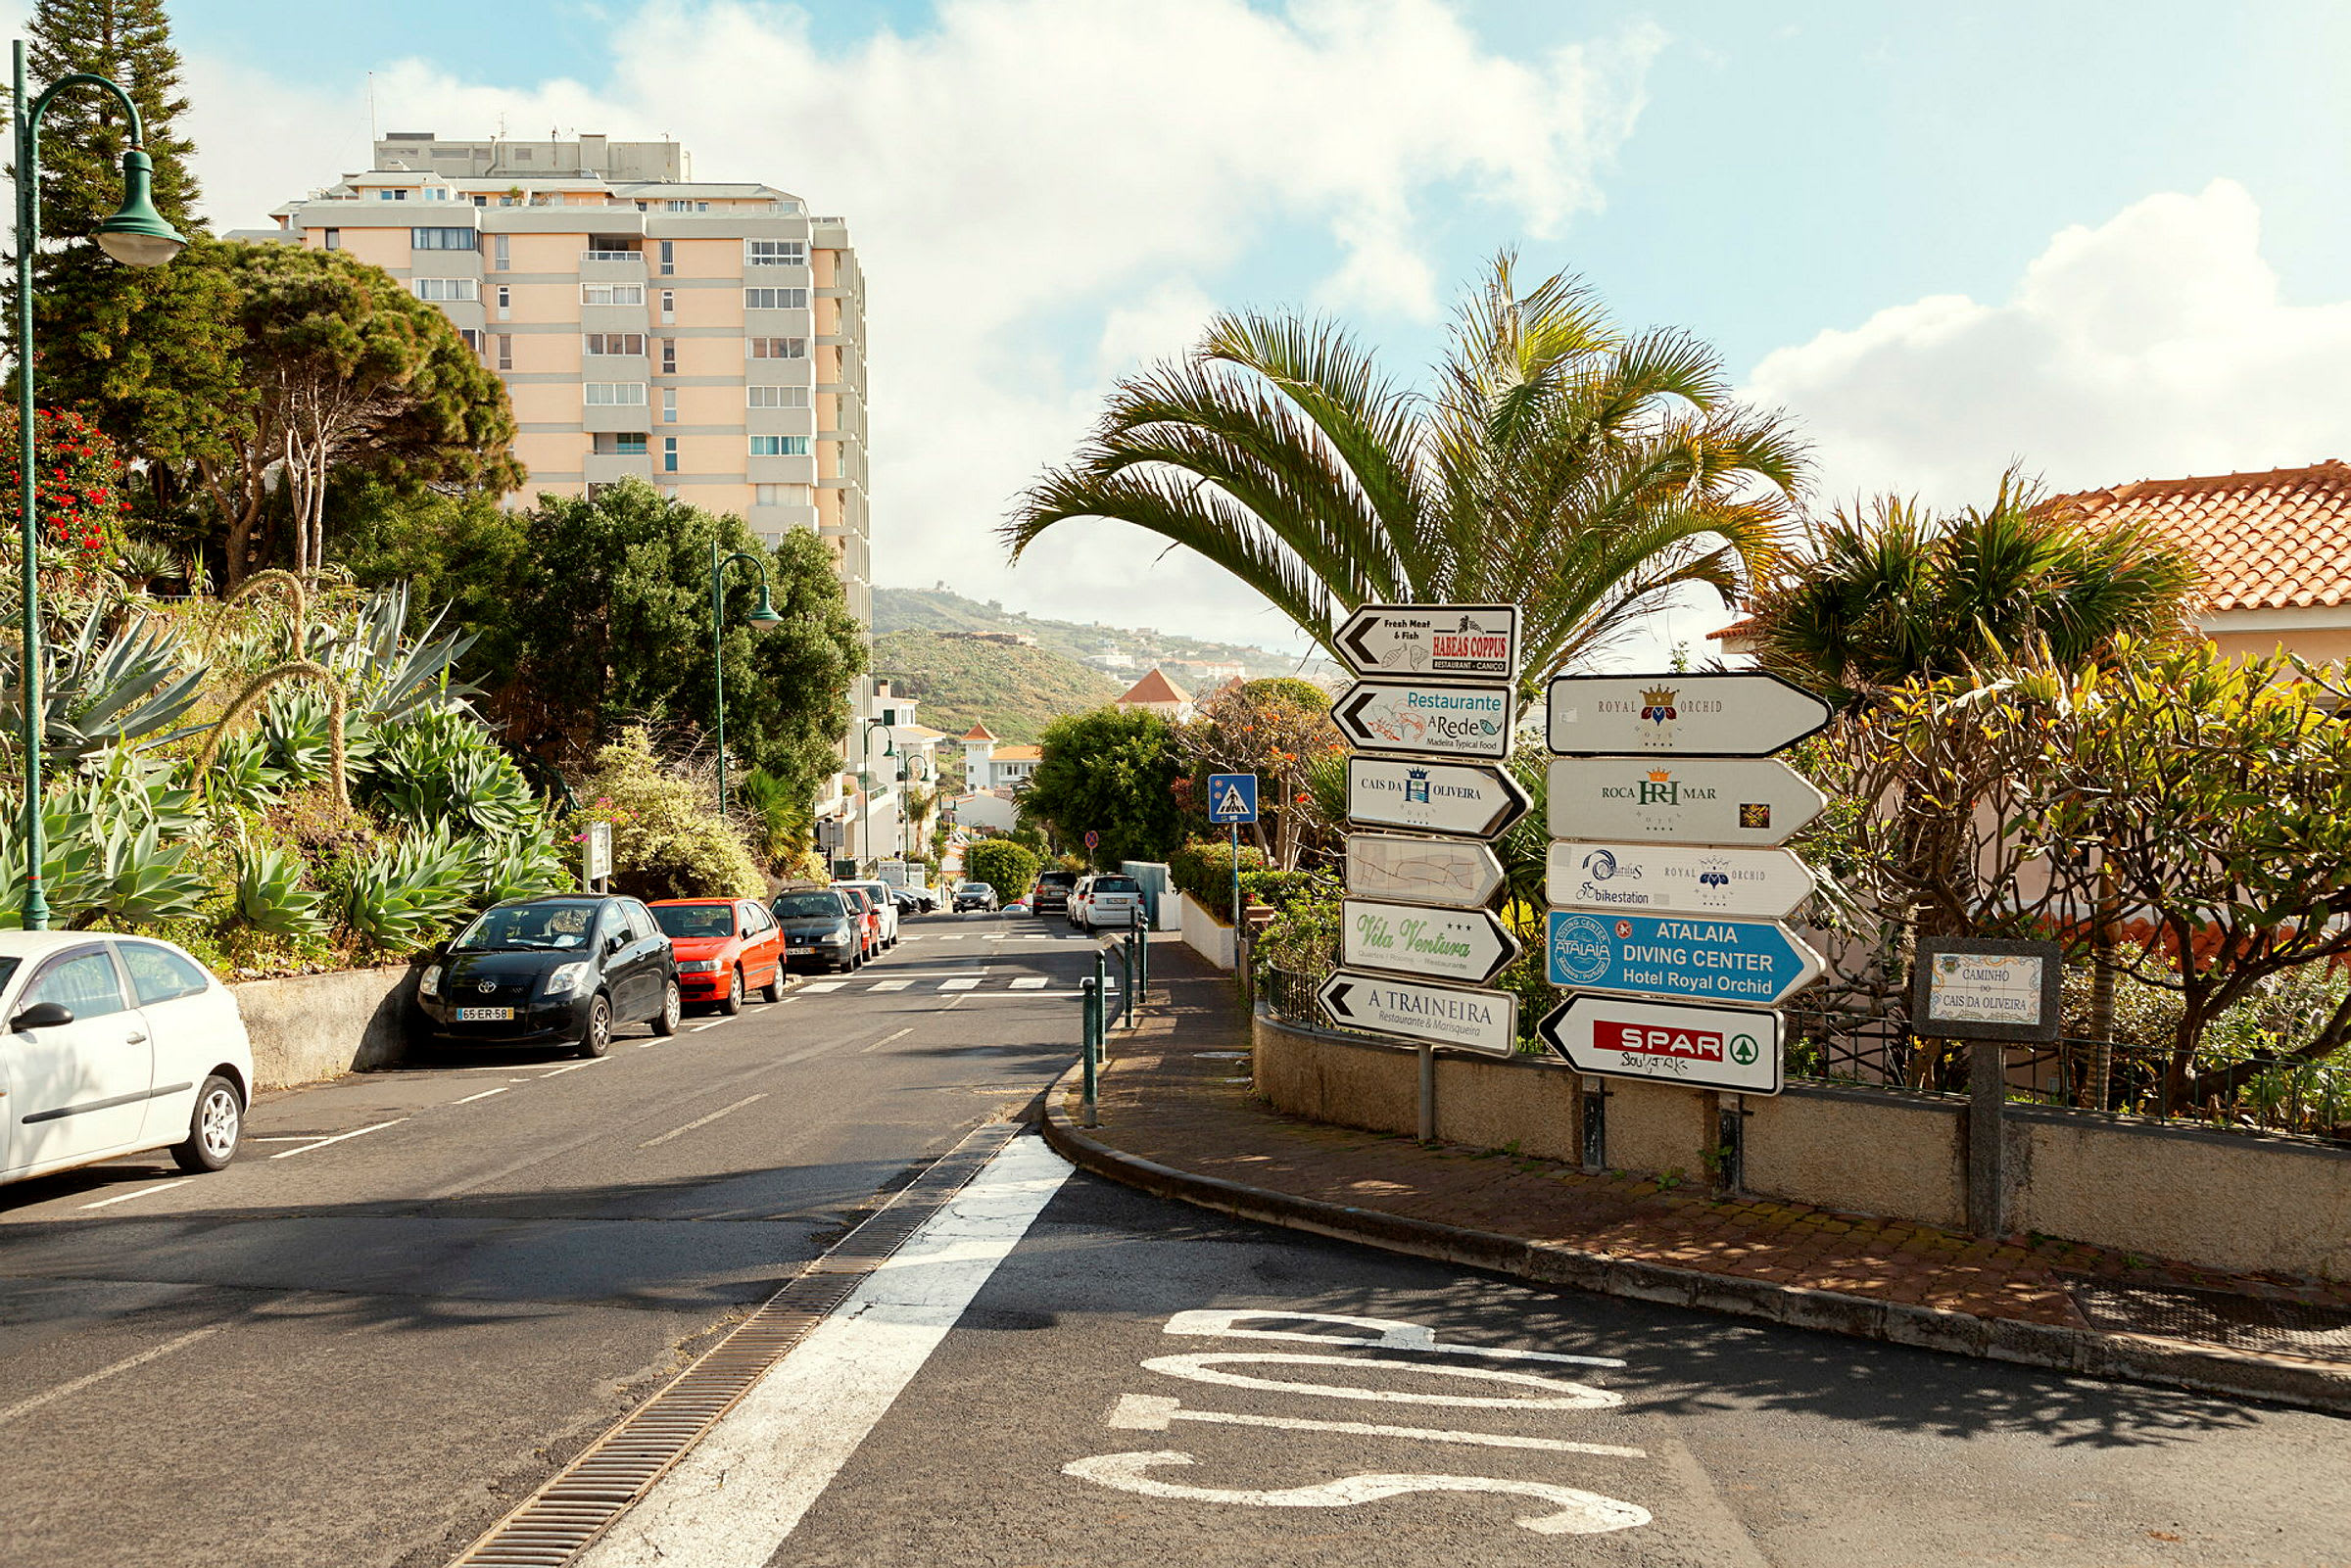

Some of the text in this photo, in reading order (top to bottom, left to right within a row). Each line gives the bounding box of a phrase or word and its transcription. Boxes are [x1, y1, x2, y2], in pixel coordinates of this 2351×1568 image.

[1433, 637, 1507, 658] HABEAS COPPUS
[1434, 660, 1470, 670] RESTAURANT
[1476, 662, 1505, 671] CANIÇO
[1408, 691, 1502, 711] Restaurante
[1598, 700, 1722, 713] ROYAL ORCHID
[1428, 716, 1479, 738] A Rede
[1427, 737, 1454, 747] Madeira
[1456, 739, 1477, 749] Typical
[1361, 779, 1385, 790] CAIS
[1388, 781, 1403, 791] DA
[1433, 784, 1481, 800] OLIVEIRA
[1602, 787, 1635, 798] ROCA
[1683, 787, 1716, 799] MAR
[1664, 867, 1766, 880] ROYAL ORCHID
[1595, 888, 1649, 904] bikestation
[1357, 914, 1470, 958] Vila Ventura
[1656, 922, 1738, 944] ATALAIA
[1424, 958, 1467, 970] Restaurante
[1623, 944, 1773, 973] DIVING CENTER
[1623, 968, 1772, 995] Hotel Royal Orchid
[1962, 969, 2010, 982] CAMINHO
[1980, 984, 1991, 993] DO
[1368, 989, 1492, 1024] A TRAINEIRA
[1943, 994, 2027, 1011] CAIS DA OLIVEIRA
[1378, 1010, 1481, 1036] Restaurante & Marisqueira
[1621, 1028, 1720, 1057] SPAR
[1061, 1308, 1654, 1536] STOP
